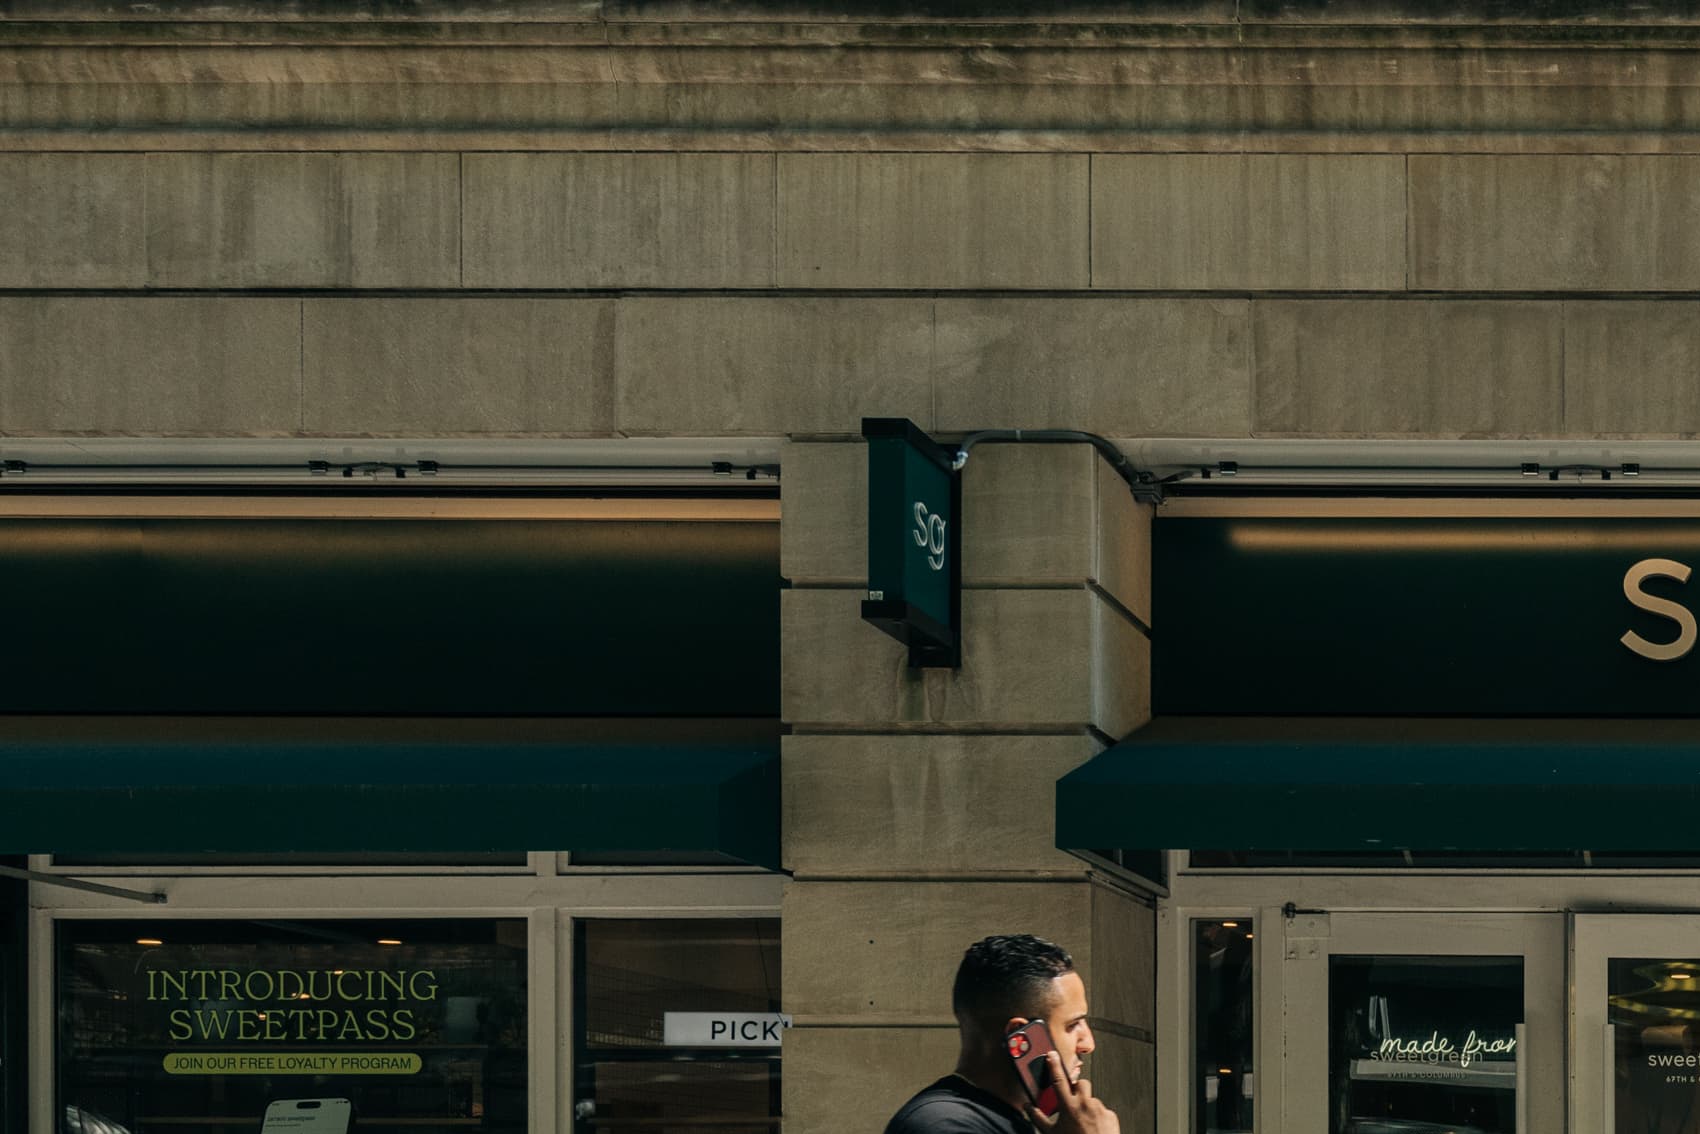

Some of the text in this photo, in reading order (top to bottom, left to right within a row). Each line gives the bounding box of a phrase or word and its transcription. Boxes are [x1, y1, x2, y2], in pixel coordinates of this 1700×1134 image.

[913, 502, 946, 570] sg
[147, 971, 438, 1000] INTRODUCING
[169, 1010, 415, 1040] SWEETPASS
[712, 1021, 788, 1040] PICK
[1380, 1031, 1454, 1053] made
[174, 1057, 410, 1069] JOIN OUR FREE LOYALTY PROGRAM
